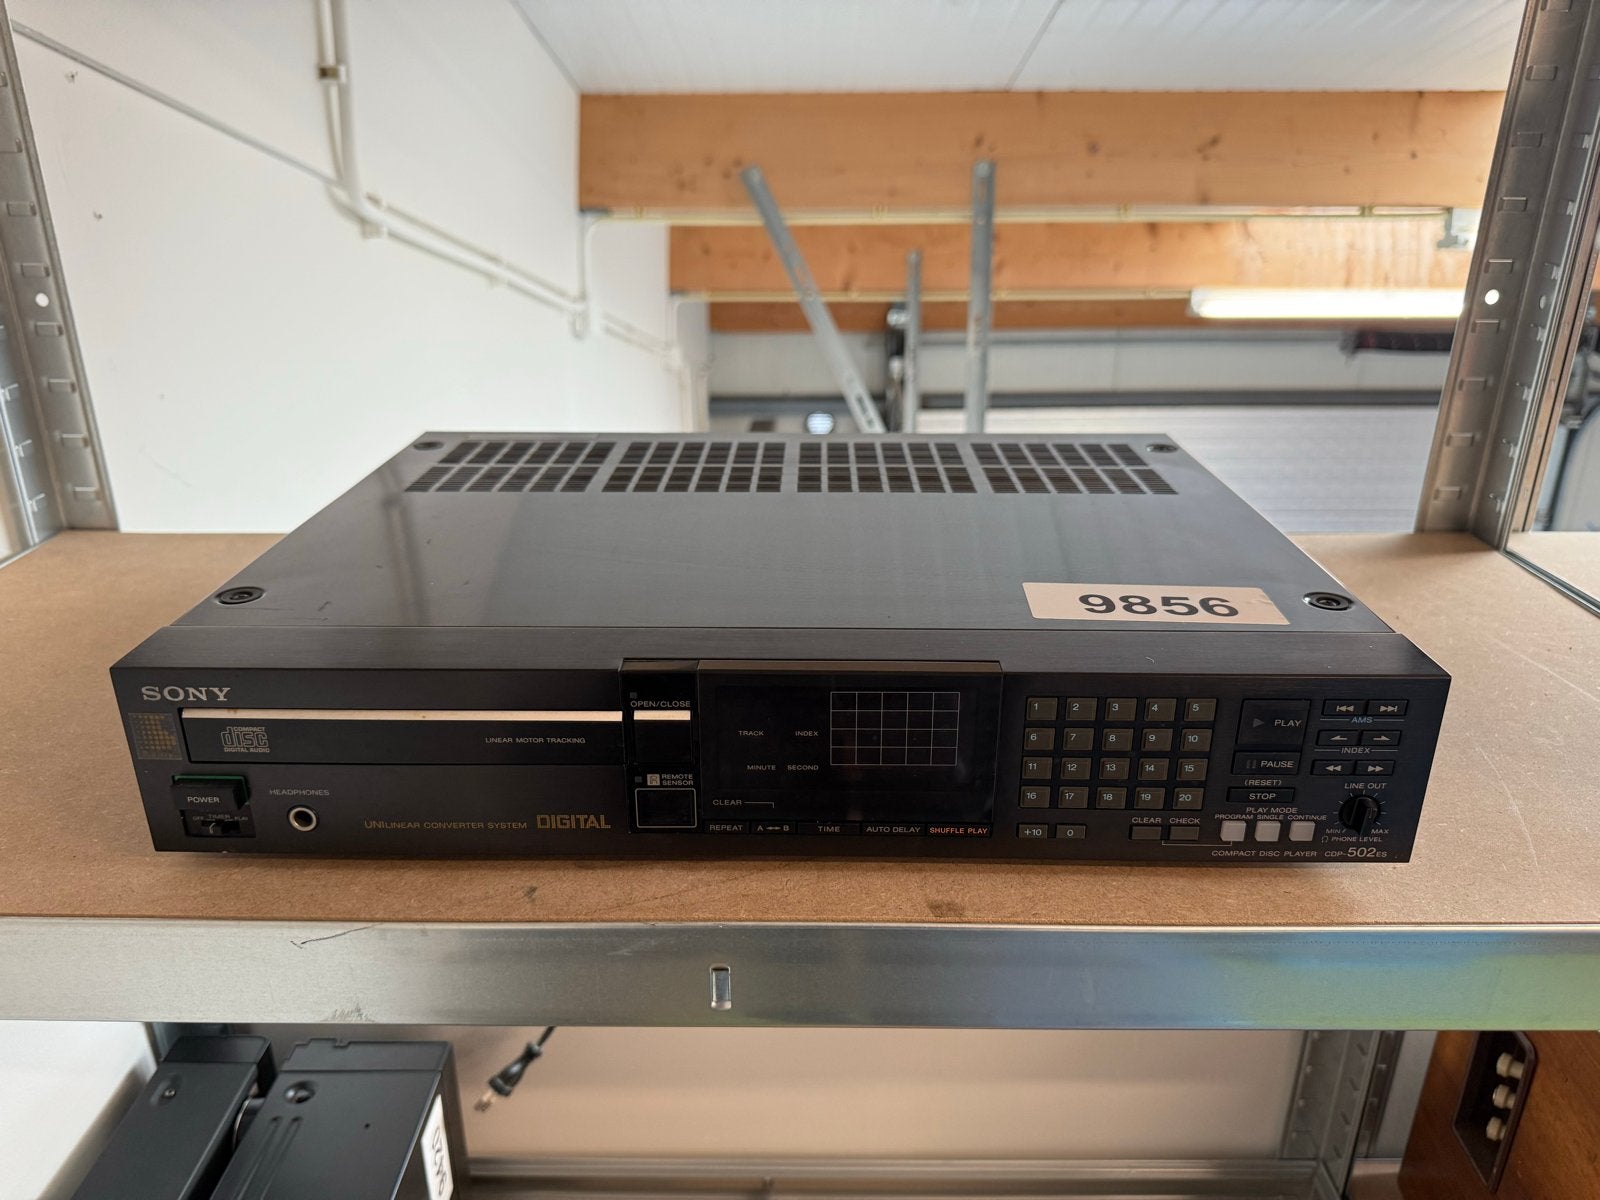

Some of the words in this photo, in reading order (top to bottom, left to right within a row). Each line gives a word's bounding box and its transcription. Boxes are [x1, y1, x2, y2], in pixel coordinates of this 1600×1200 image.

[1078, 593, 1239, 617] 9856
[141, 686, 231, 701] SONY
[630, 700, 691, 708] OPEN/CLOSE
[1033, 703, 1038, 711] 1
[1072, 703, 1080, 711] 2
[1112, 703, 1119, 711] 3
[1151, 704, 1159, 712] 4
[1192, 704, 1199, 712] 5
[1274, 719, 1302, 727] PLAY
[1030, 733, 1037, 741] 6
[1070, 733, 1077, 741] 7
[1109, 734, 1116, 742] 8
[1148, 734, 1156, 742] 9
[1187, 735, 1198, 743] 10
[1067, 763, 1077, 771] 12
[1144, 764, 1155, 772] 14
[1260, 760, 1295, 768] PAUSE
[1367, 782, 1388, 790] OUT
[187, 796, 220, 804] POWER
[1026, 792, 1037, 800] 16
[1064, 792, 1075, 800] 17
[1103, 793, 1113, 801] 18
[1141, 793, 1152, 801] 19
[536, 814, 612, 829] DIGITAL
[1169, 817, 1201, 825] CHECK
[818, 825, 841, 833] TIME
[929, 827, 965, 835] SHUFFLE
[967, 827, 988, 835] PLAY
[1024, 828, 1042, 837] +10
[1066, 829, 1074, 837] 0
